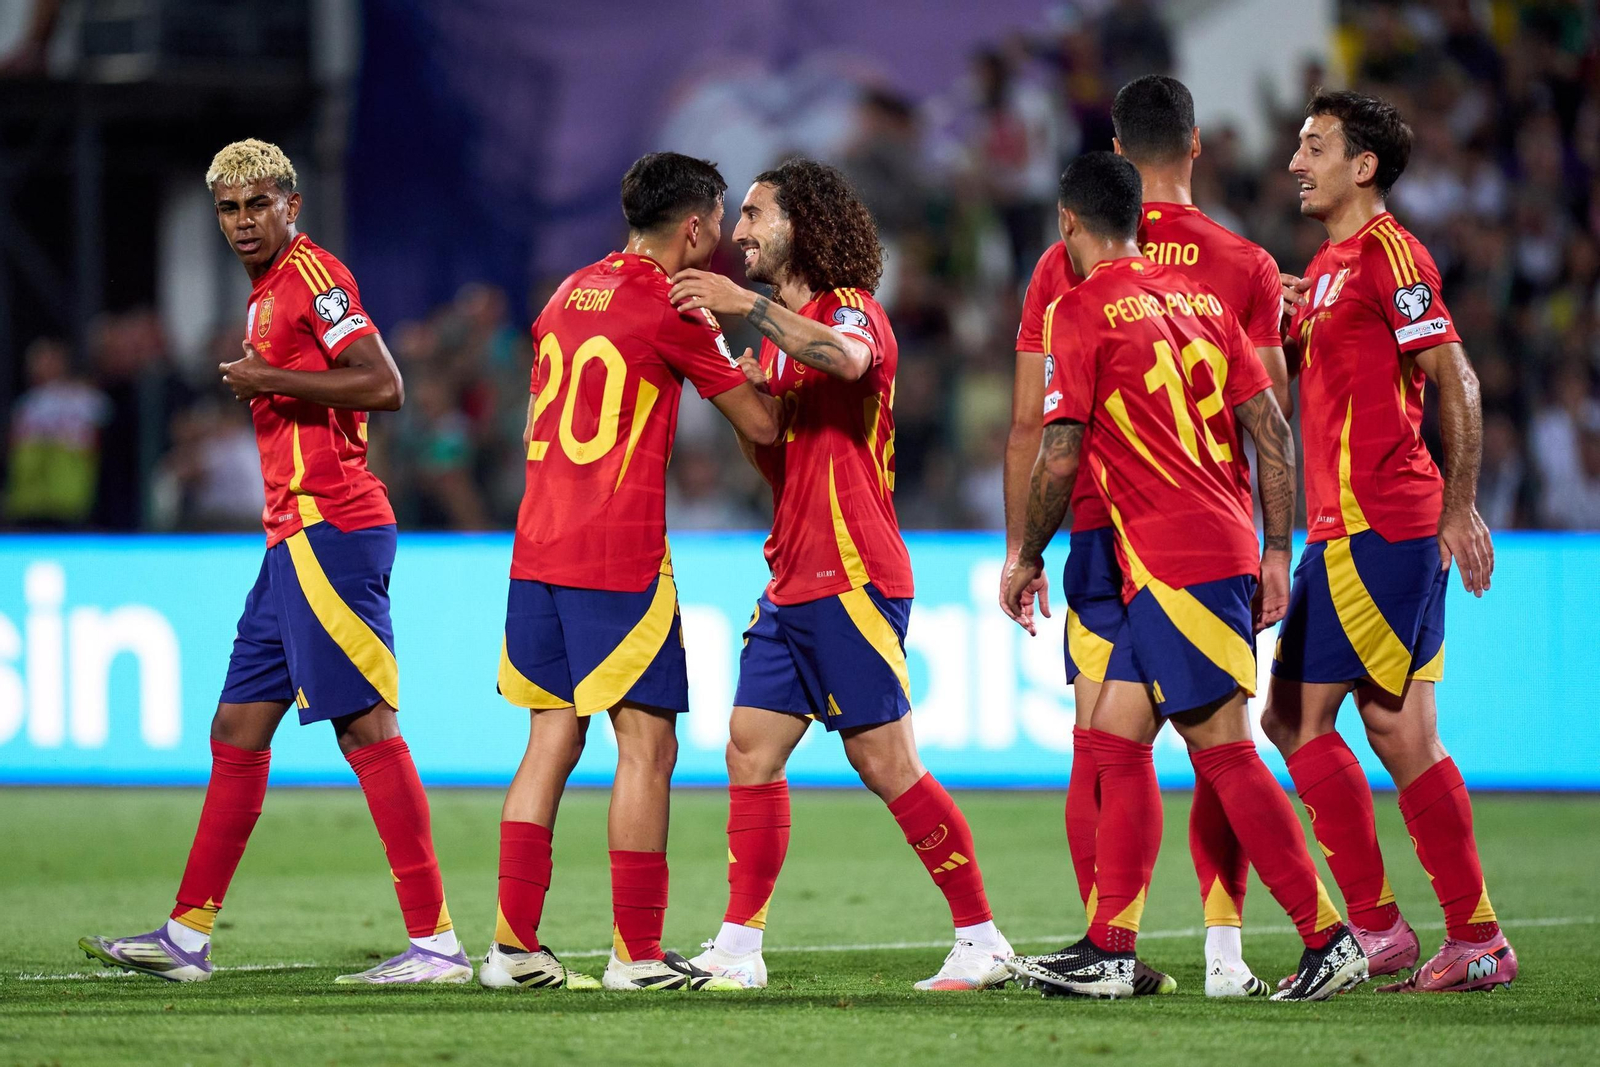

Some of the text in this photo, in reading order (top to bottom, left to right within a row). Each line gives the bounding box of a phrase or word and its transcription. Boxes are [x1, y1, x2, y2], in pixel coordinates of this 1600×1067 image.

[1143, 242, 1199, 266] RINO
[564, 288, 615, 312] PEDRI
[1430, 321, 1444, 331] 10
[527, 332, 627, 465] 20
[1143, 337, 1234, 467] 12
